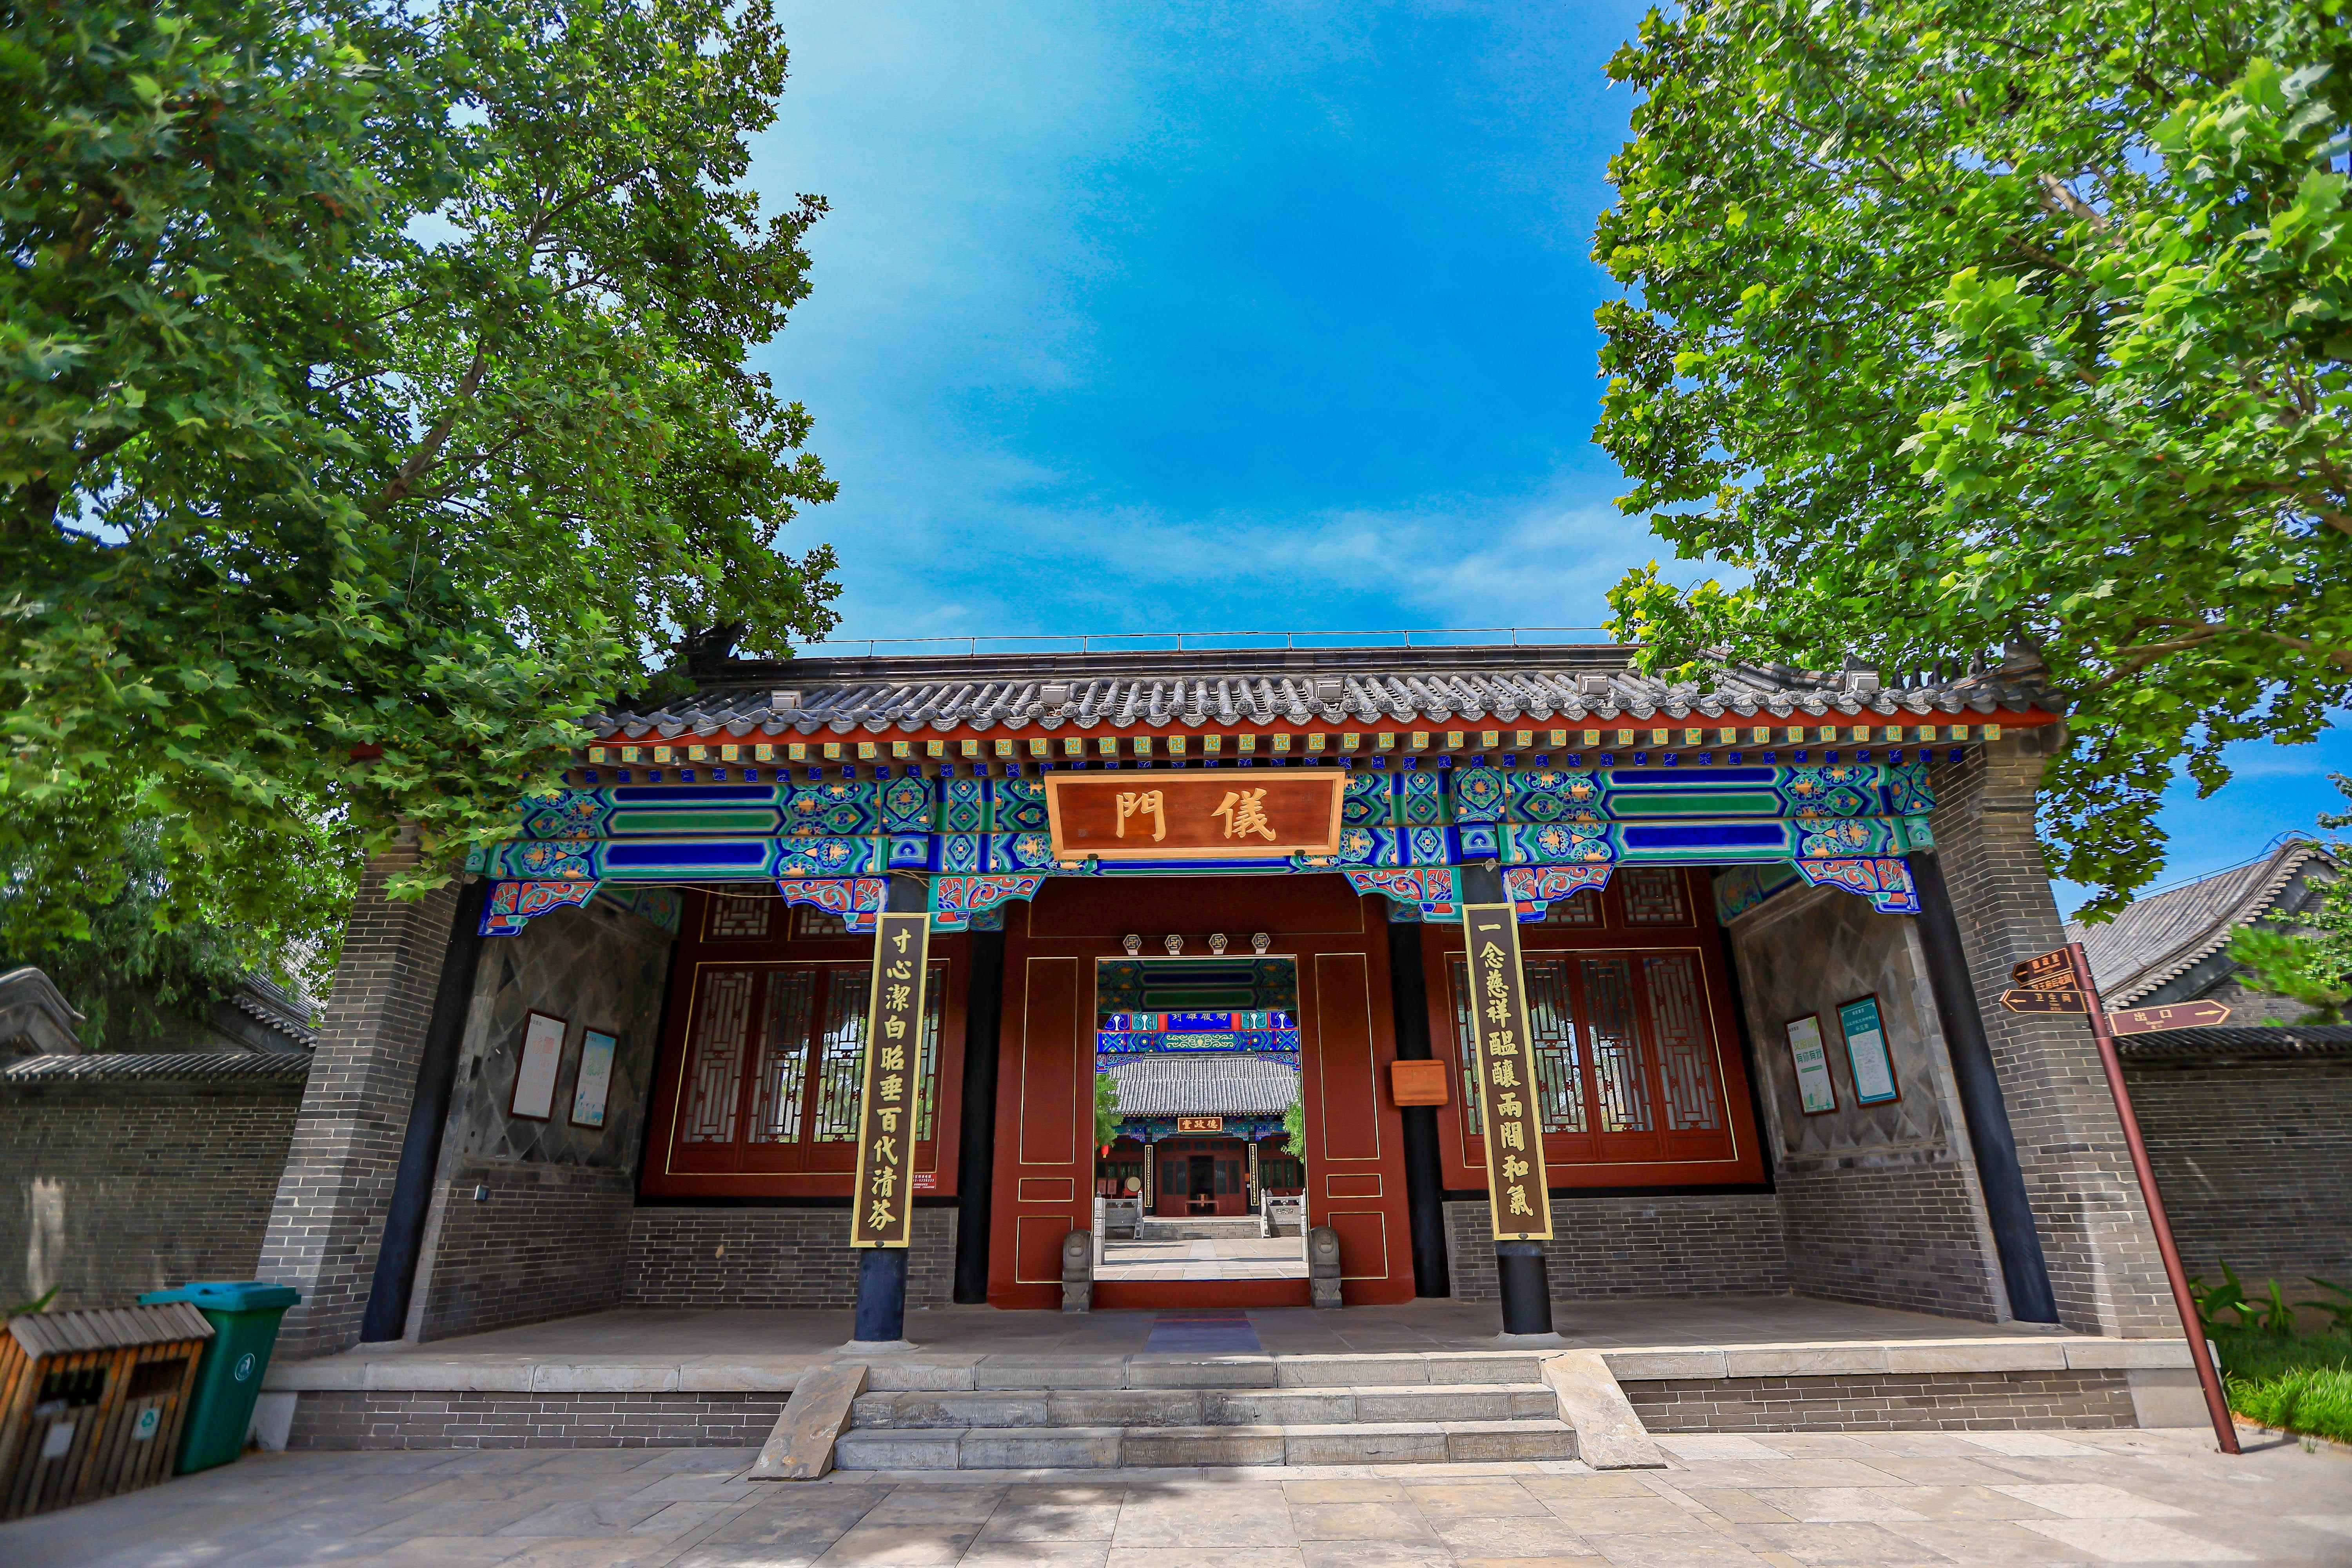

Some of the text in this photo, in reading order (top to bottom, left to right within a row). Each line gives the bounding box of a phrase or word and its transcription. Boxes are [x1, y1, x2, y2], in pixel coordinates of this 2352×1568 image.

[2034, 993, 2072, 1002] 卫生间
[2133, 1009, 2173, 1022] 出口
[867, 928, 912, 1231] 寸心潔白昭垂百代清芬
